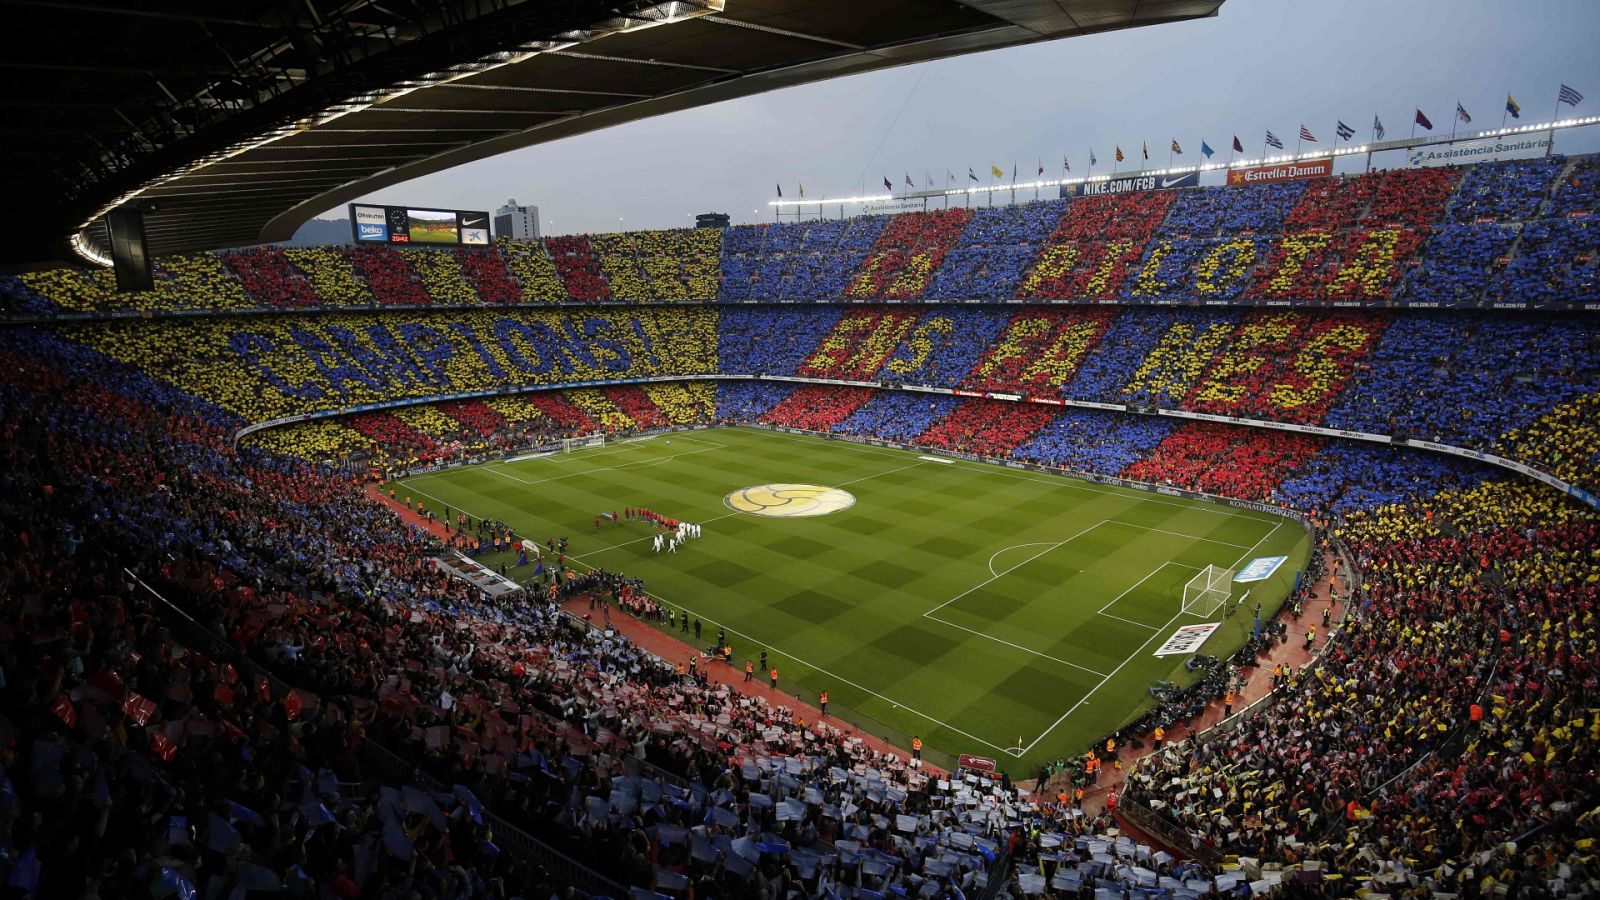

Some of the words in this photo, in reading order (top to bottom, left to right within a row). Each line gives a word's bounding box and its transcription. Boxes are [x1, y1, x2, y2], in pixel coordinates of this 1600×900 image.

[1426, 146, 1494, 161] Assistència
[1494, 139, 1549, 153] Sanitària
[1244, 167, 1287, 182] Estrella
[1287, 164, 1325, 178] Damm
[1083, 177, 1156, 196] NIKE.COM/FCB
[361, 225, 382, 234] beko
[1061, 471, 1086, 480] KONAMI
[1131, 482, 1149, 491] beko
[1229, 500, 1262, 512] KONAMI
[1265, 505, 1302, 522] Rakuten
